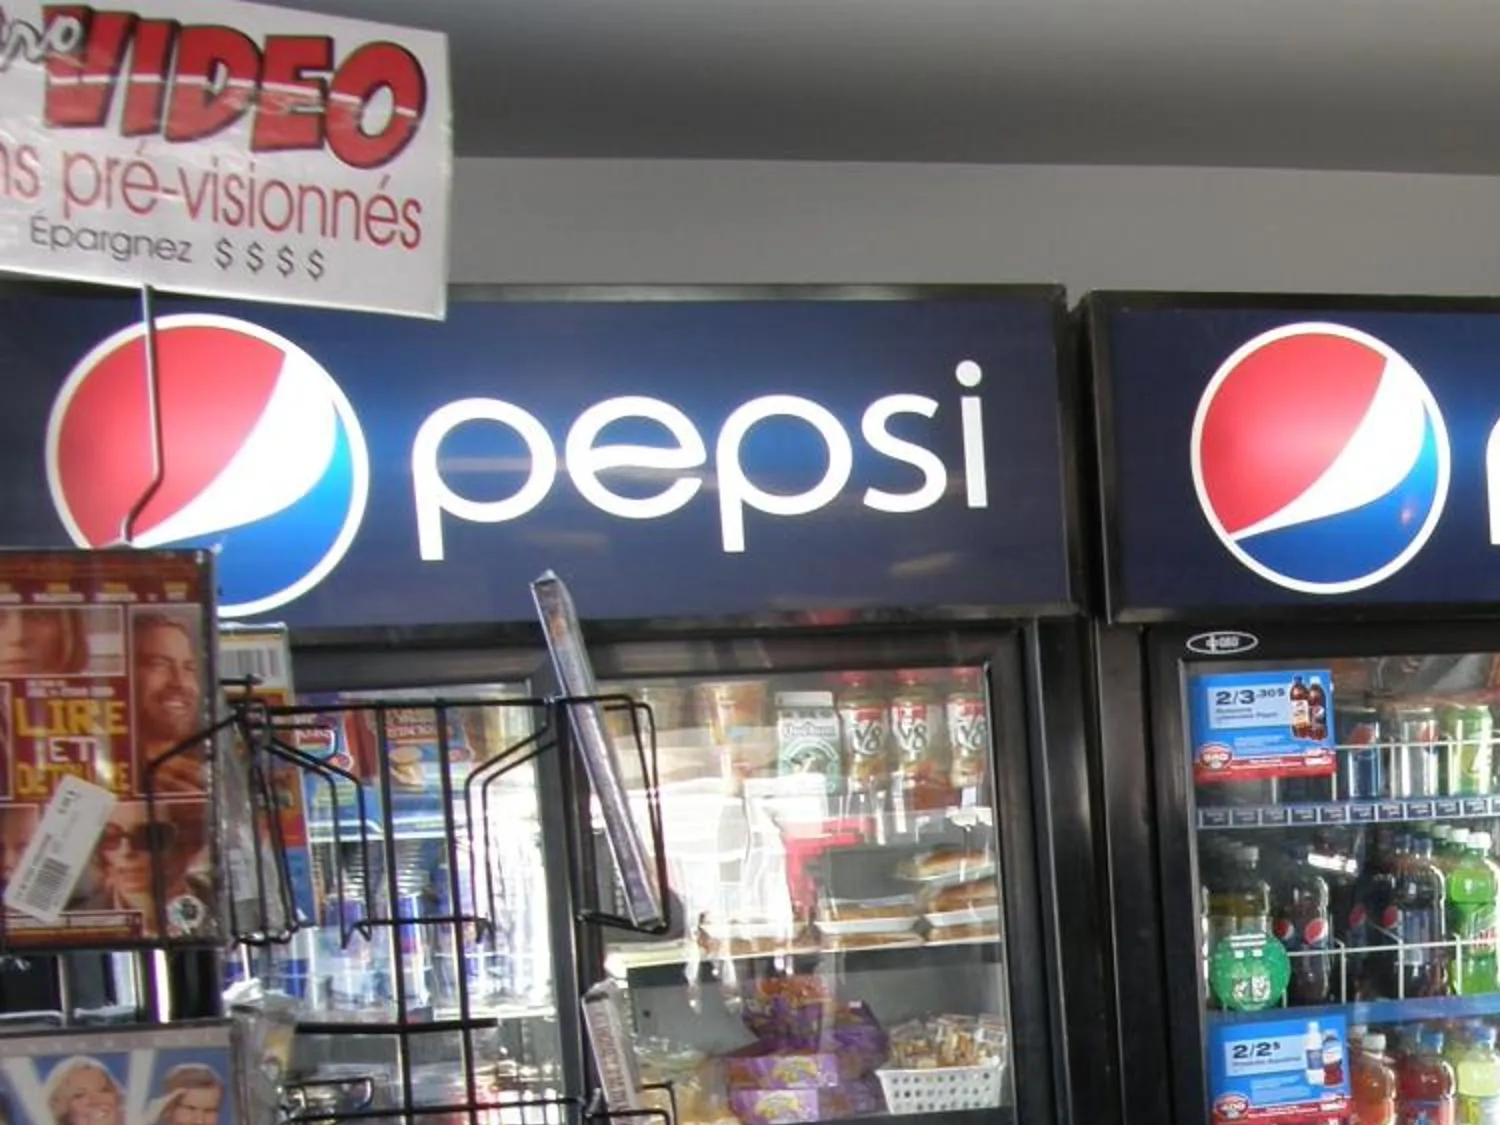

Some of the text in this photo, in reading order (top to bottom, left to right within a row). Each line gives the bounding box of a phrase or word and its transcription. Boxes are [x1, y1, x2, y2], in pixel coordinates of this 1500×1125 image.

[42, 5, 427, 169] VIDEO
[62, 143, 422, 250] pré-visionnés
[30, 216, 192, 263] Épargnez
[411, 360, 988, 560] pepsi
[15, 697, 129, 736] LIRE
[49, 736, 98, 762] ET
